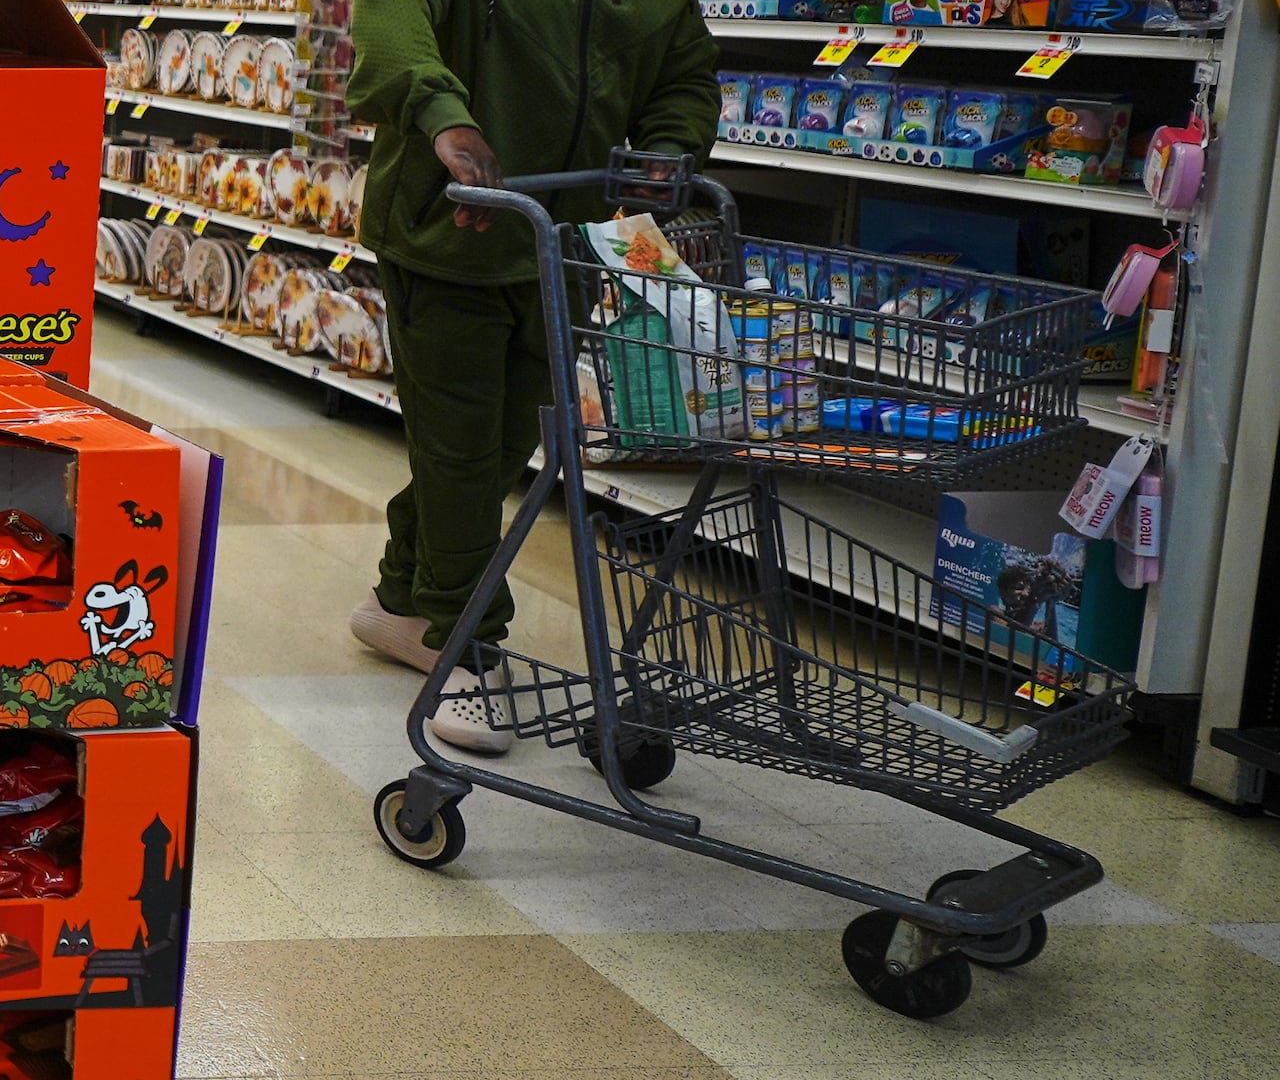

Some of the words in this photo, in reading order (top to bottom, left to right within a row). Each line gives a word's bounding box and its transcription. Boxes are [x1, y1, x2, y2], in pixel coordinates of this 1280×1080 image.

[1088, 490, 1116, 529] meow
[941, 528, 976, 549] Aqua
[1139, 506, 1152, 546] meow
[937, 558, 992, 584] DRENCHERS
